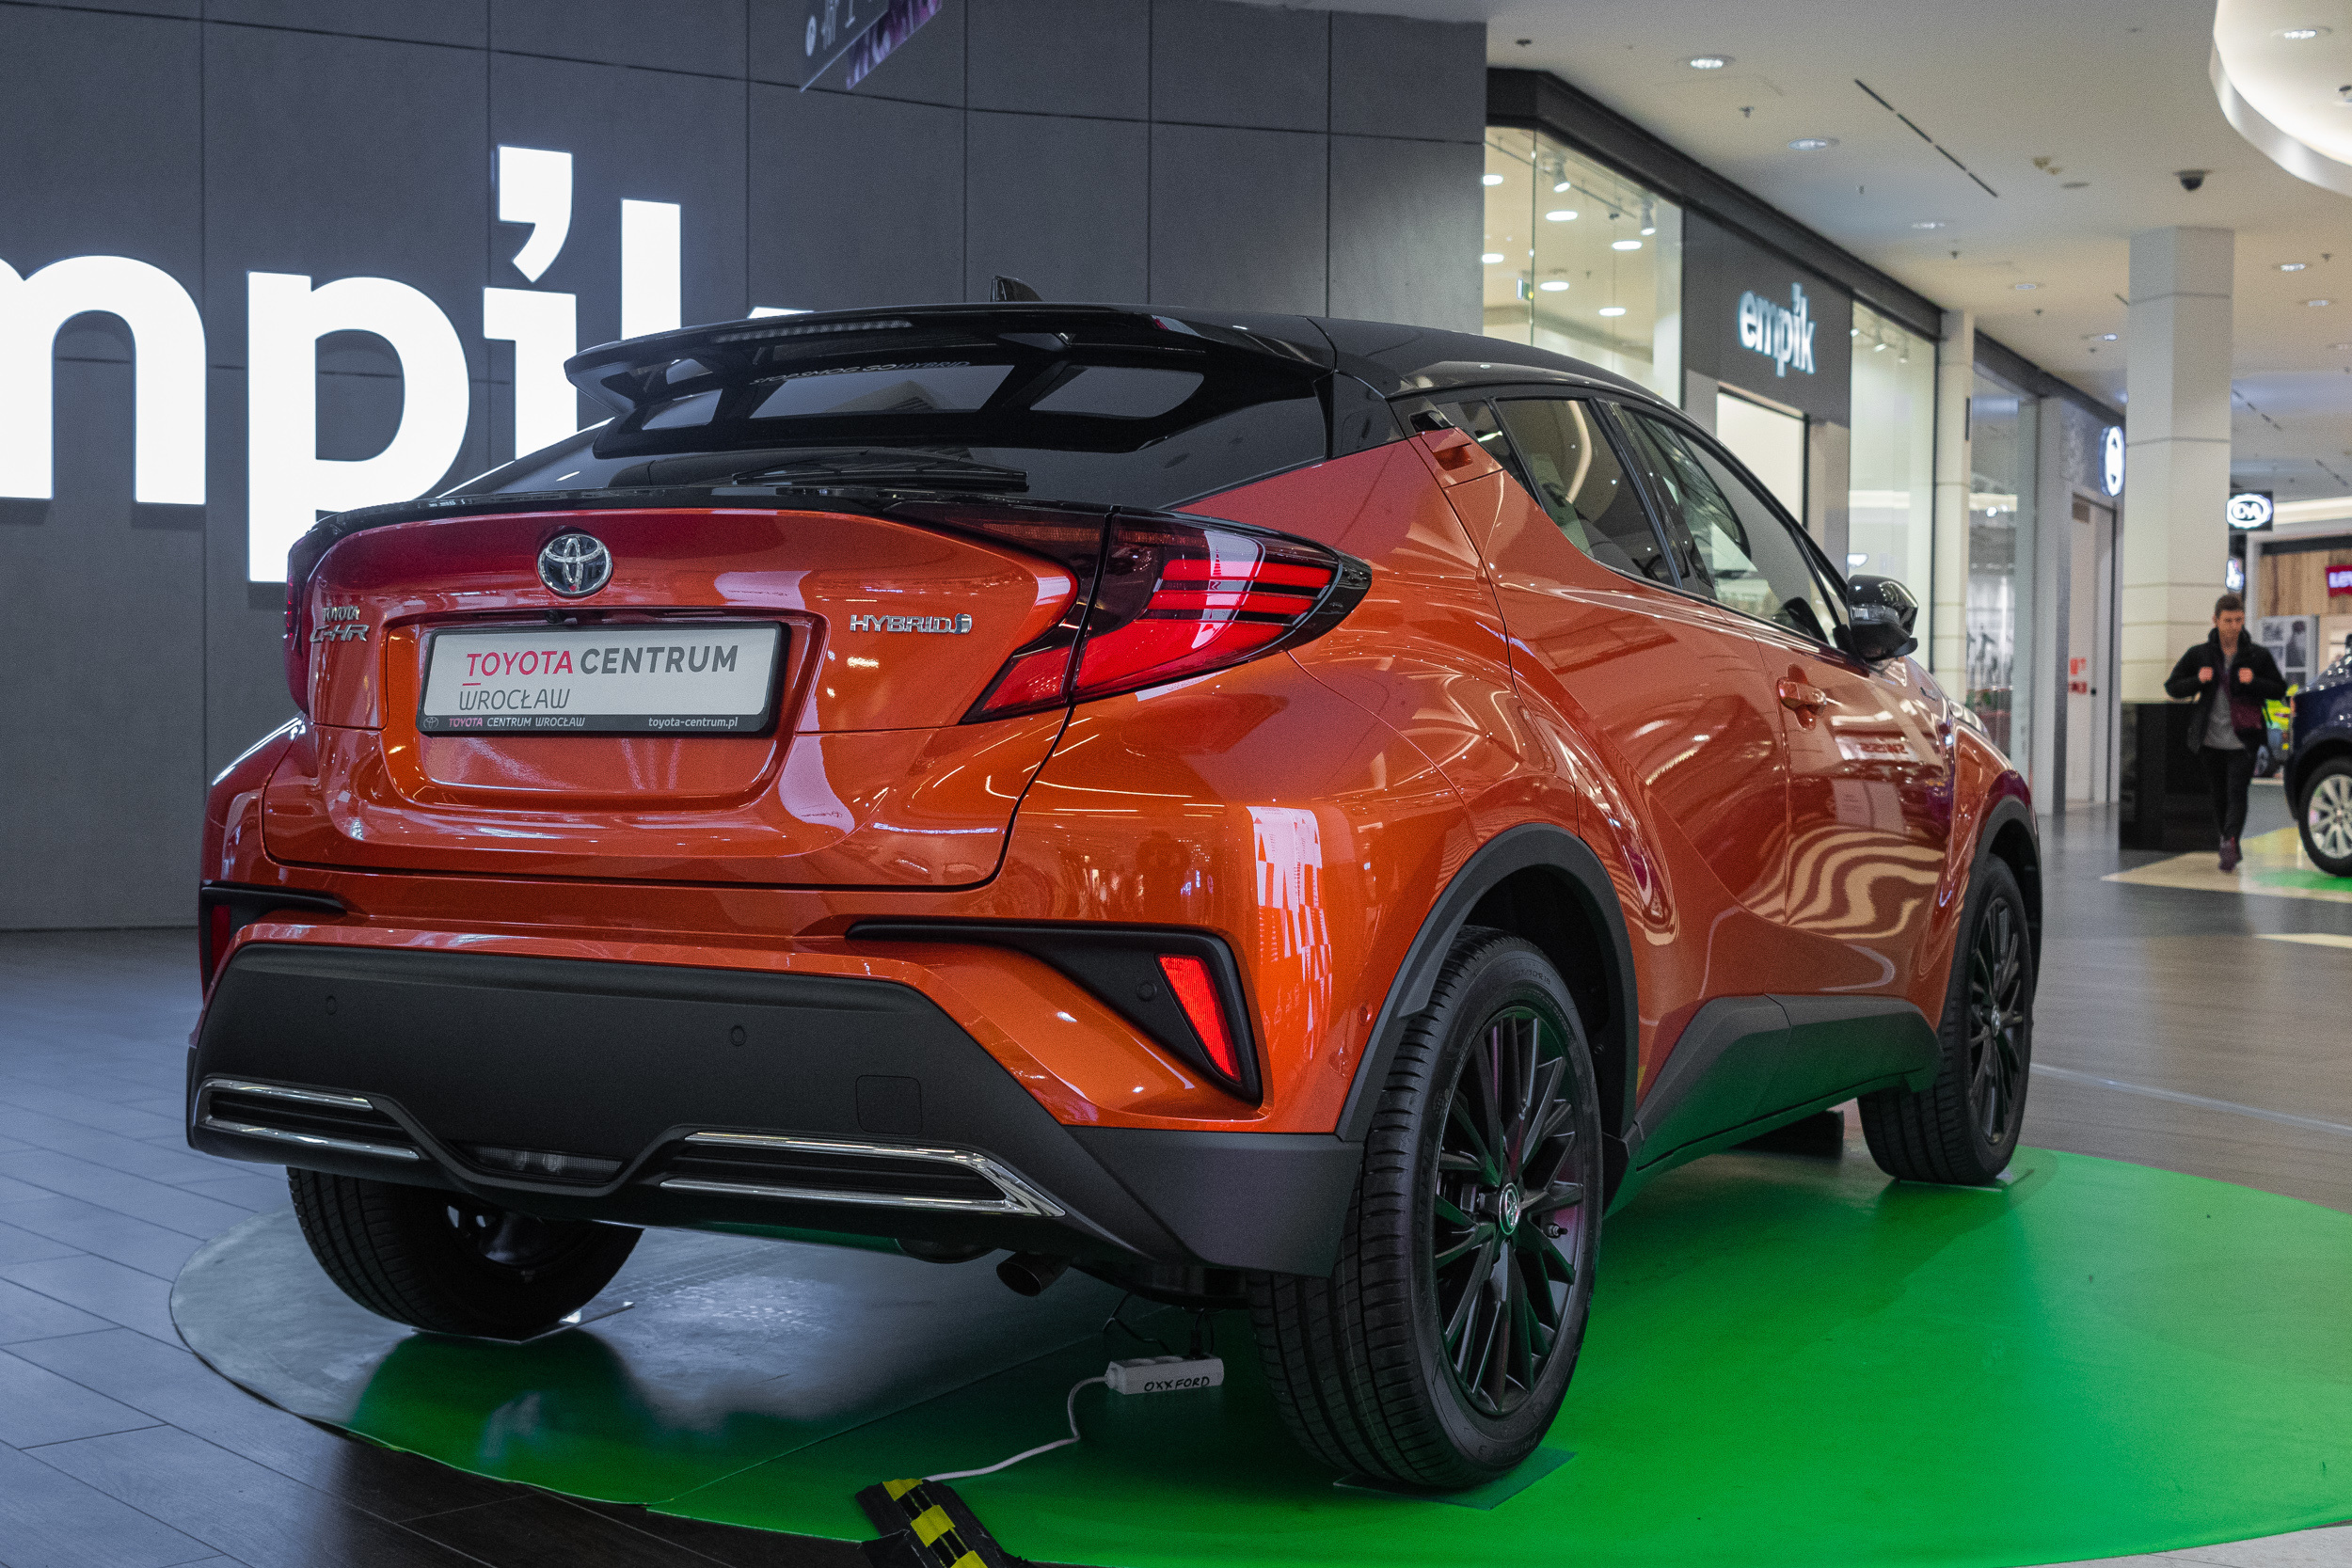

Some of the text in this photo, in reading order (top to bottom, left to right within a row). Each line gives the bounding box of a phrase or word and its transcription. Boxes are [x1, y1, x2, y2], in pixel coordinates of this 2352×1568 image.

[1737, 281, 1817, 378] empik
[323, 605, 359, 622] TOYOTA
[850, 614, 952, 633] HYBRID
[310, 624, 370, 642] C-HR
[467, 645, 739, 676] TOYOTA CENTRUM
[459, 689, 570, 711] WROCŁAW
[449, 717, 585, 727] TOYOTA CENTRUM WROCŁAW
[648, 717, 739, 729] toyota-centrum.pl
